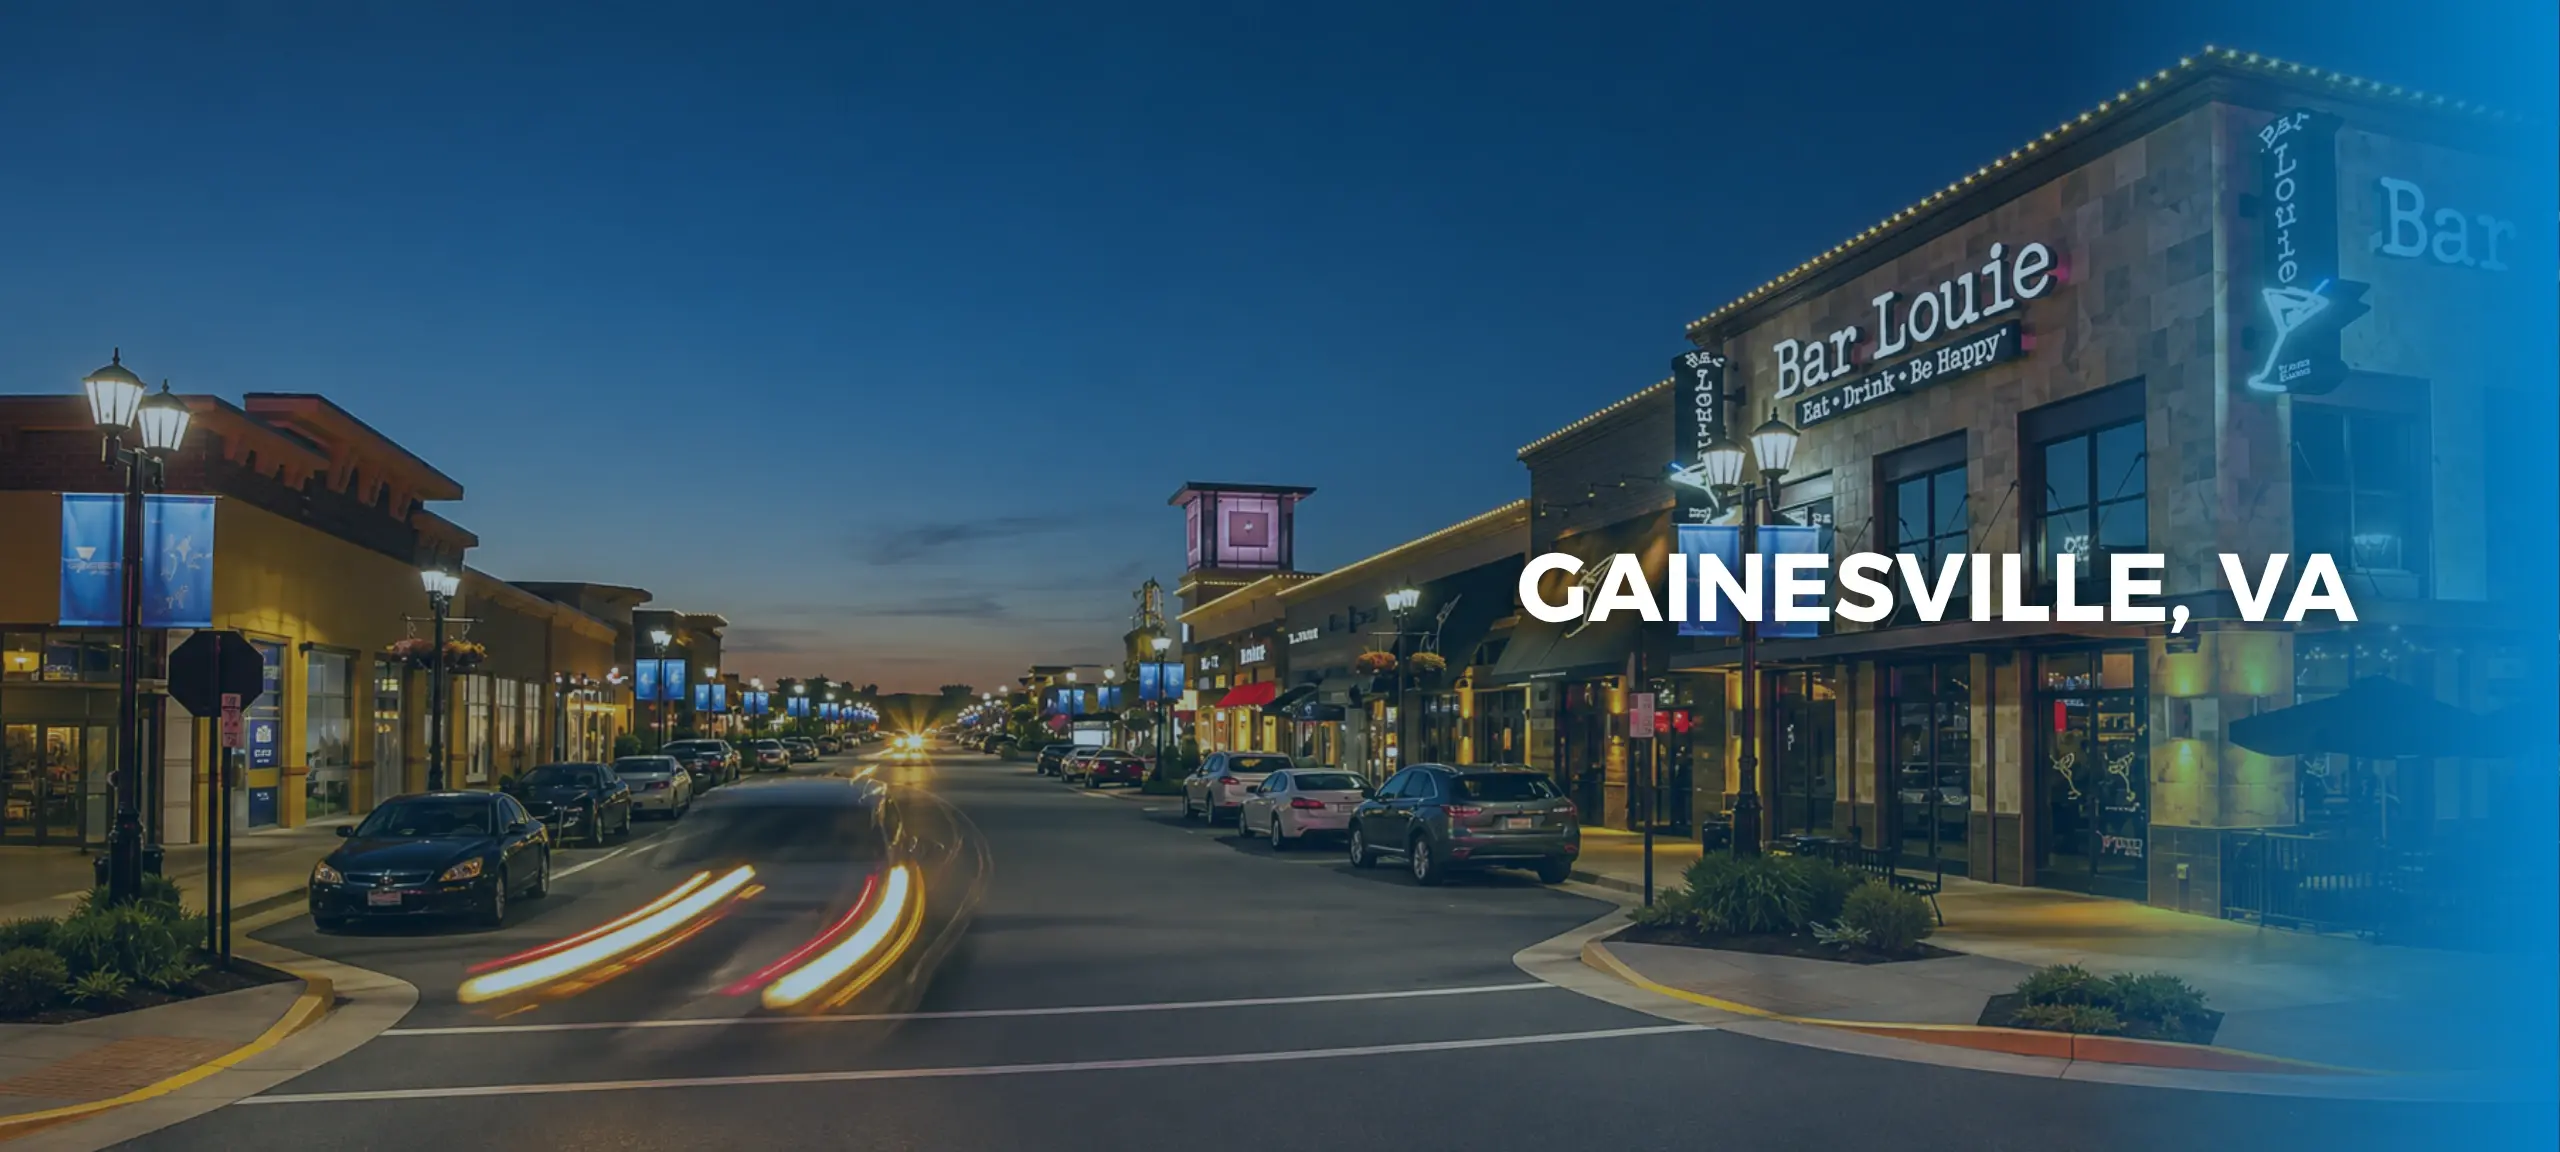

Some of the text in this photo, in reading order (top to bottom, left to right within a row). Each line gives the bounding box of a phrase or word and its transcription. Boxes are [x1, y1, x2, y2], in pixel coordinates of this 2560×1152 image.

[2258, 112, 2310, 149] Bar
[2273, 142, 2298, 283] Louie
[2380, 176, 2517, 271] Bar
[1774, 242, 2049, 400] Bar Louie
[1695, 368, 1713, 461] Loui
[1802, 334, 2000, 424] Eat Drink Be Happy
